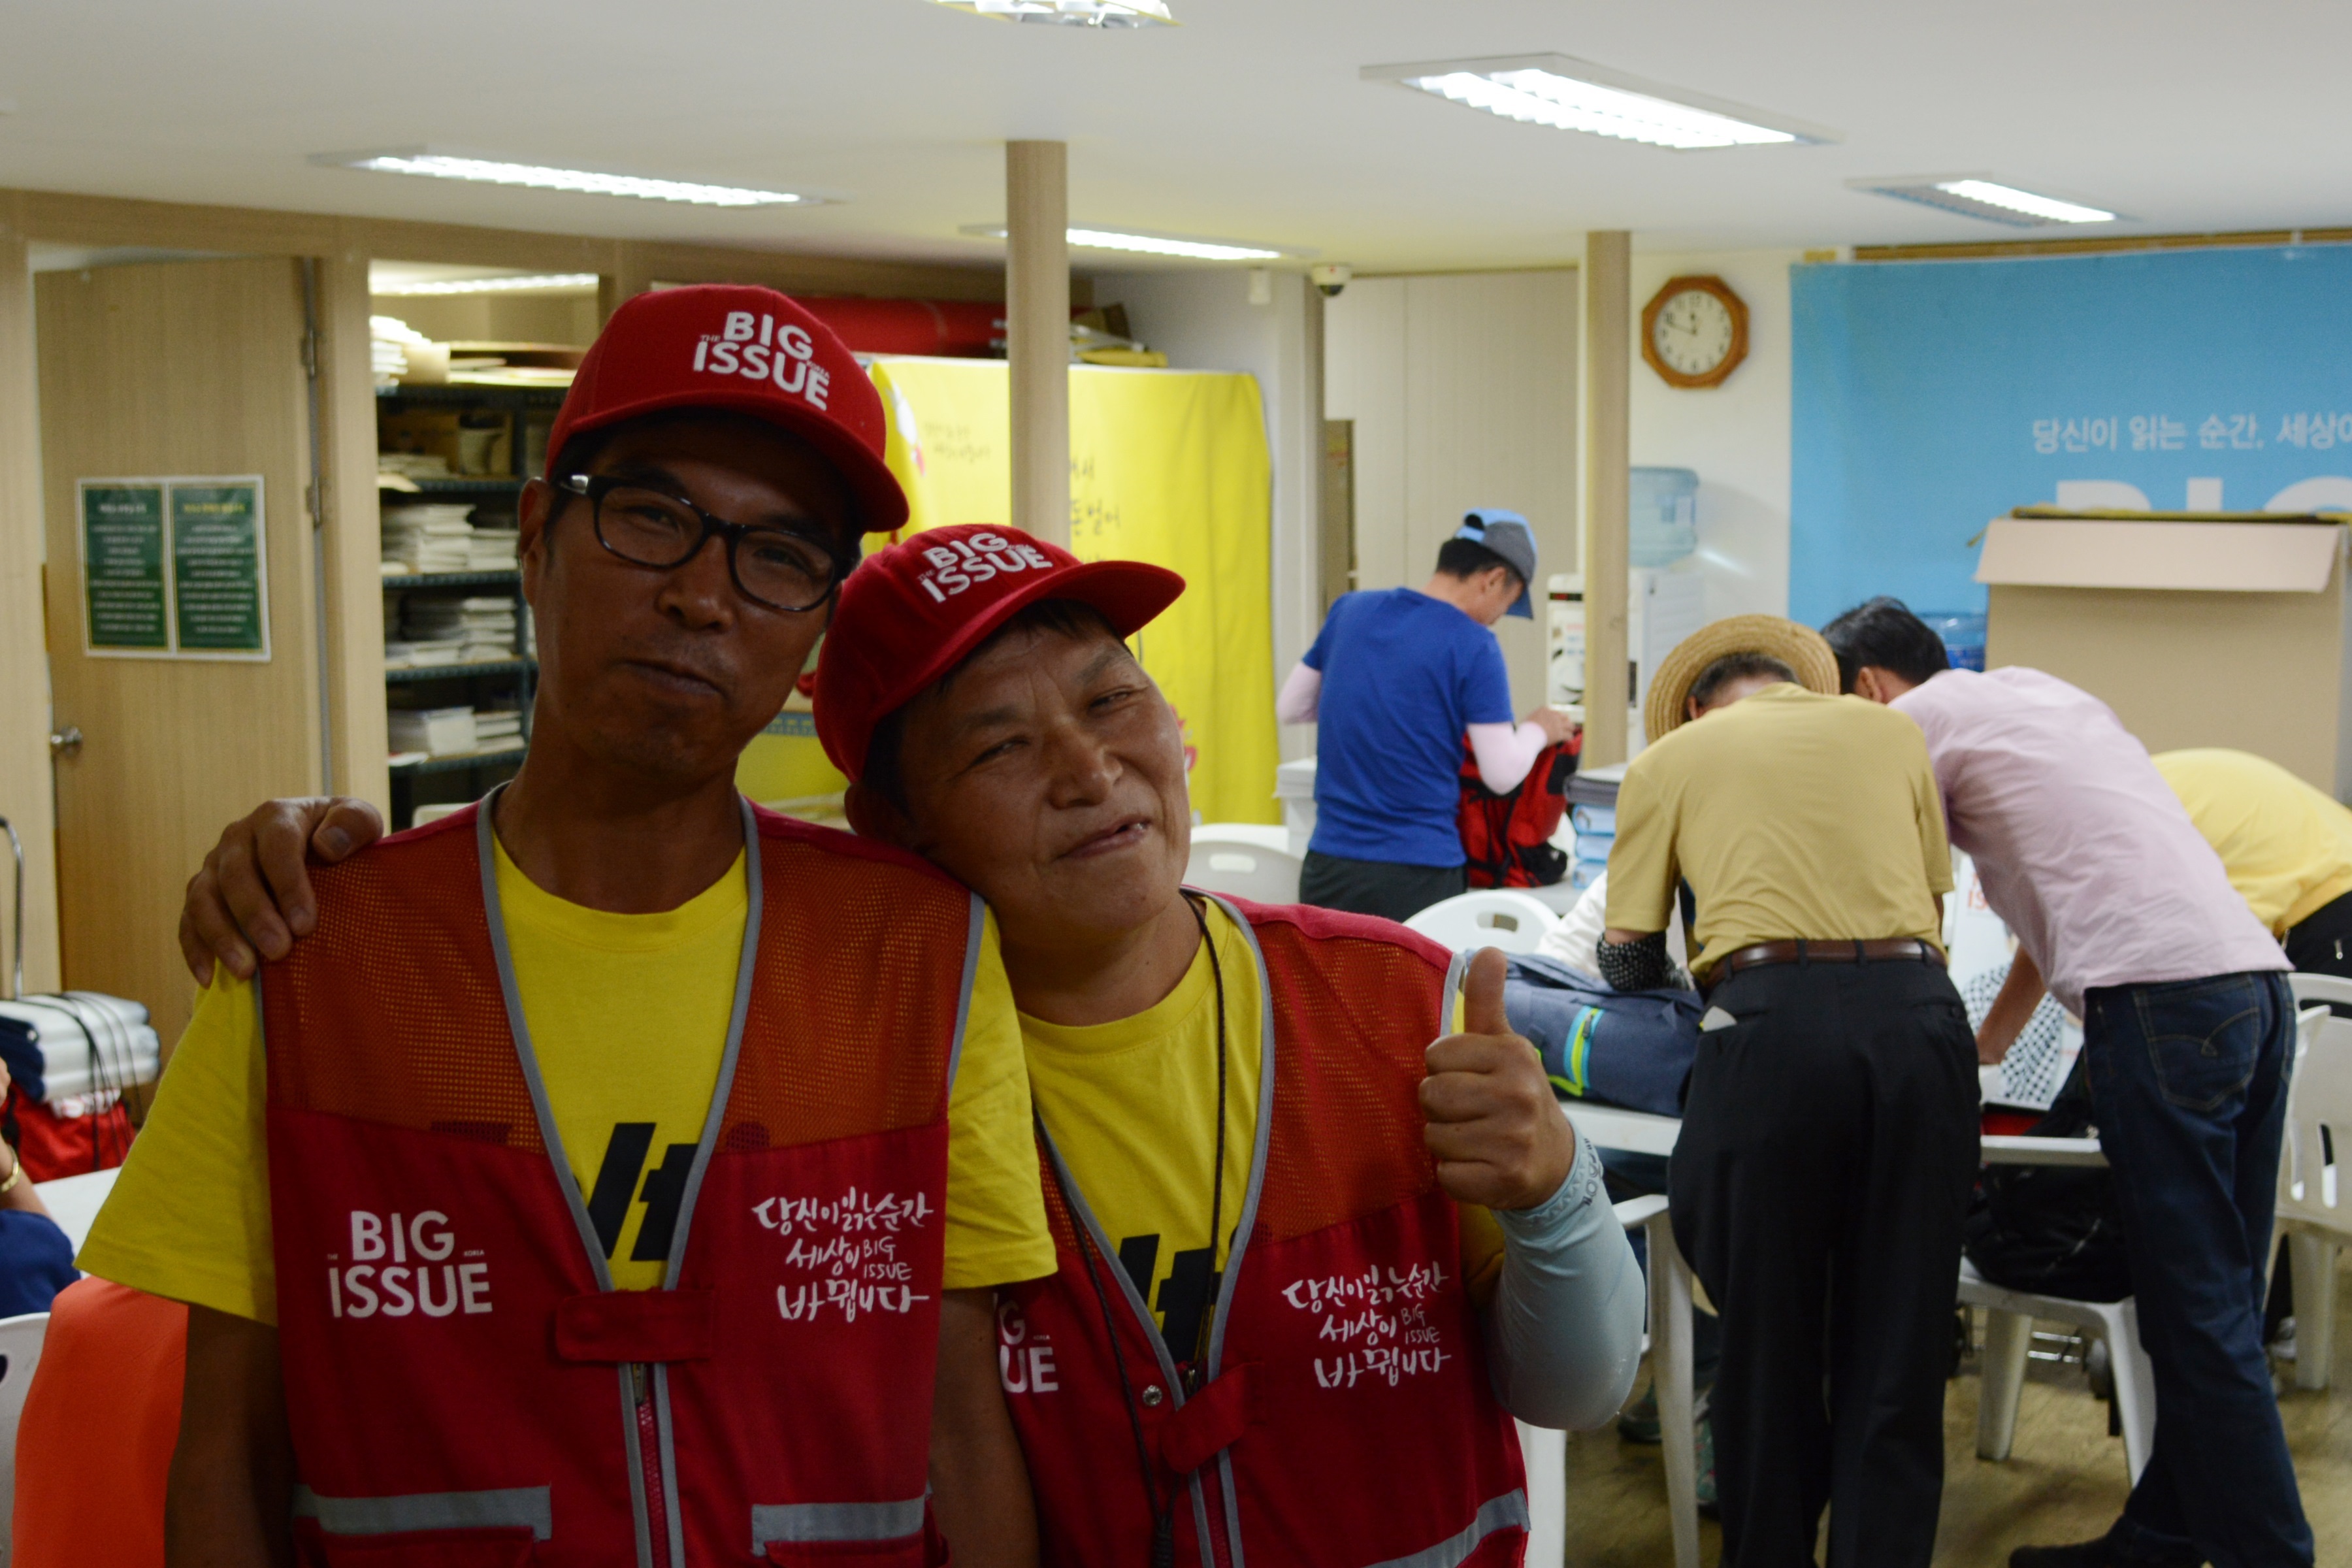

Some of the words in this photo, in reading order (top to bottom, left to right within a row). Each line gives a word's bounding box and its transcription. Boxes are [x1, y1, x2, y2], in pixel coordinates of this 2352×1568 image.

[700, 334, 721, 343] THE
[723, 311, 814, 361] BIG
[693, 341, 830, 412] ISSUE
[2033, 415, 2118, 455] 당신이
[2129, 414, 2187, 451] 읽는
[922, 532, 1008, 569] BIG
[921, 547, 1053, 604] ISSUE
[350, 1210, 455, 1264] BIG
[785, 1235, 860, 1276] 세상이
[862, 1235, 897, 1262] BIG
[329, 1262, 493, 1318] ISSUE
[863, 1262, 913, 1281] ISSUE
[777, 1278, 930, 1323] 바뀝니다
[1401, 1303, 1426, 1327] BIG
[1318, 1308, 1397, 1346] 세상이
[1405, 1326, 1441, 1345] ISSUE
[1313, 1346, 1452, 1388] 바뀝니다
